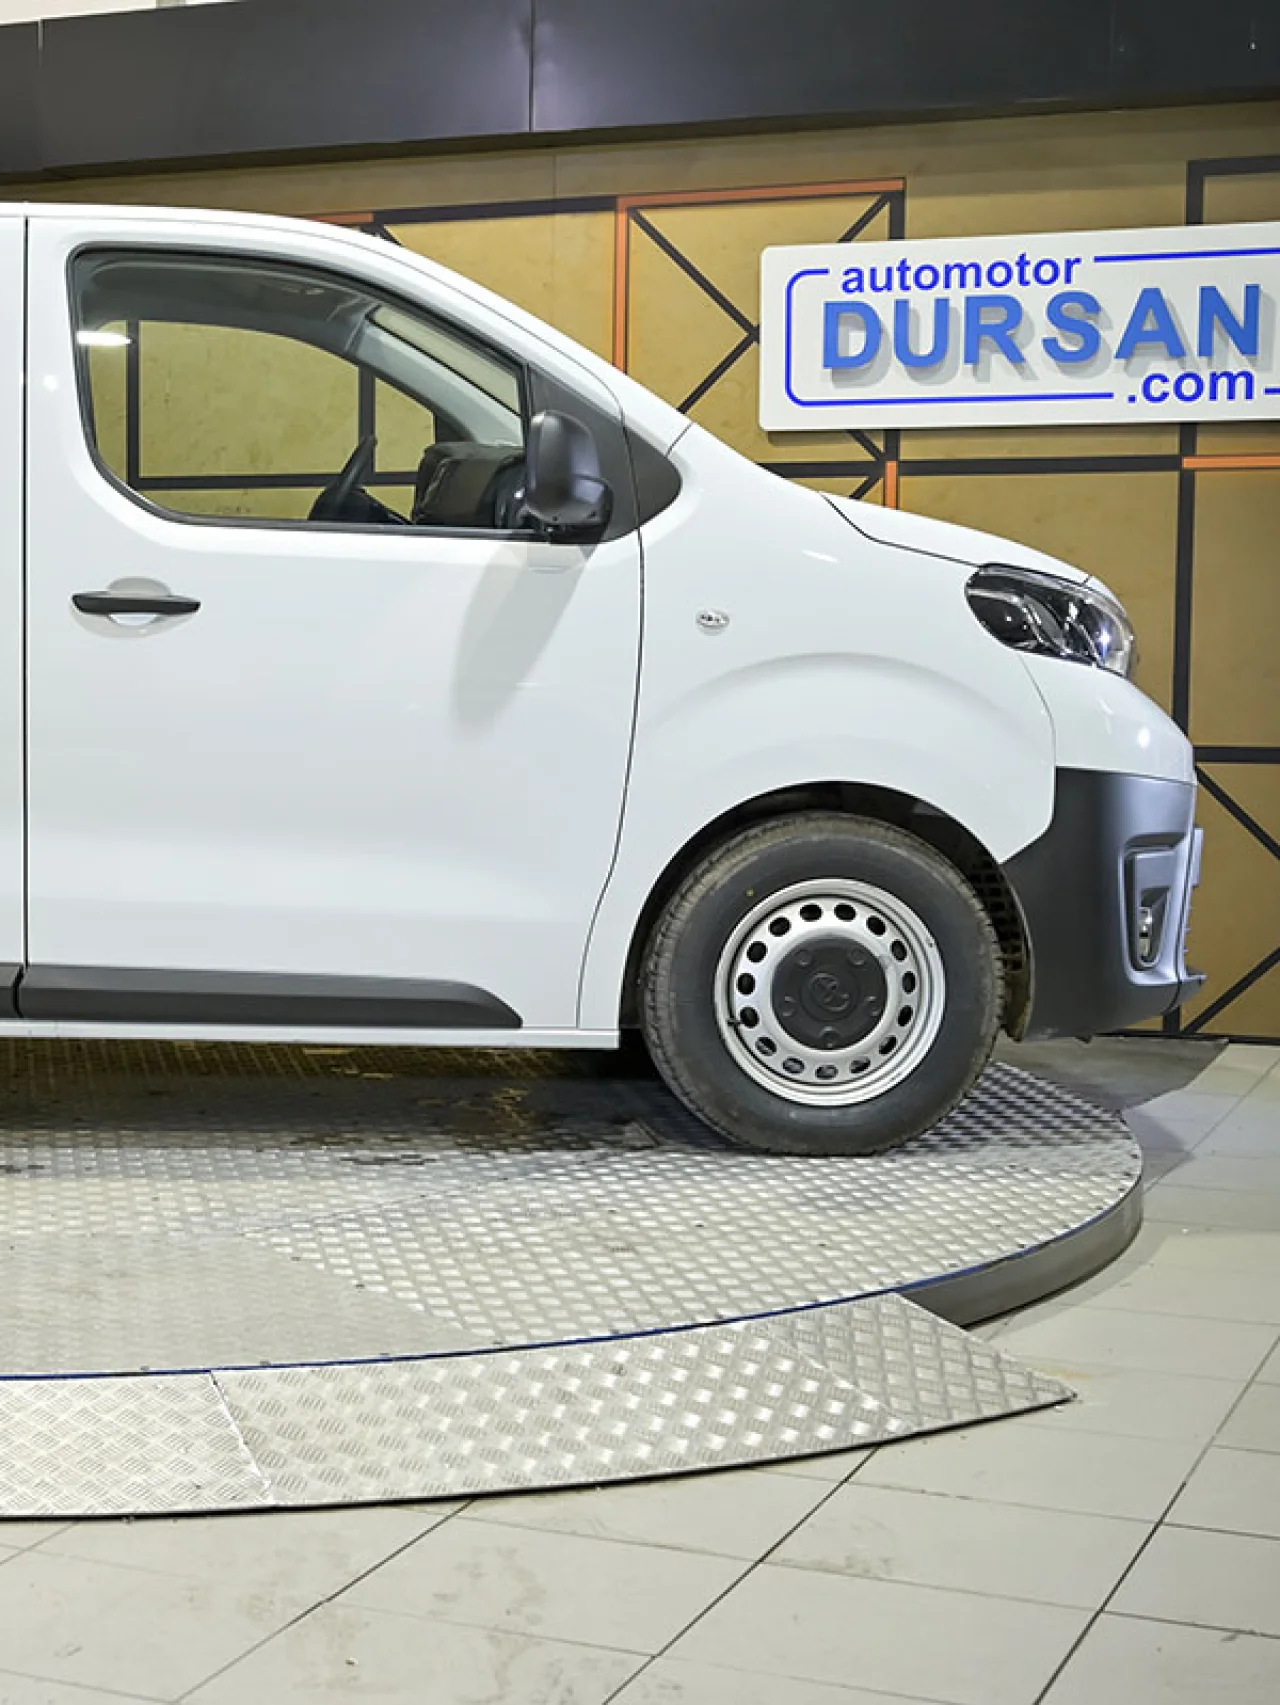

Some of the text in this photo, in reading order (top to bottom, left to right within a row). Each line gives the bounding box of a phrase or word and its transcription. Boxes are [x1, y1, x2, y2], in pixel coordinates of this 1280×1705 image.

[841, 253, 1083, 294] automotor
[822, 283, 1261, 370] DURSAN
[1127, 369, 1255, 404] .com
